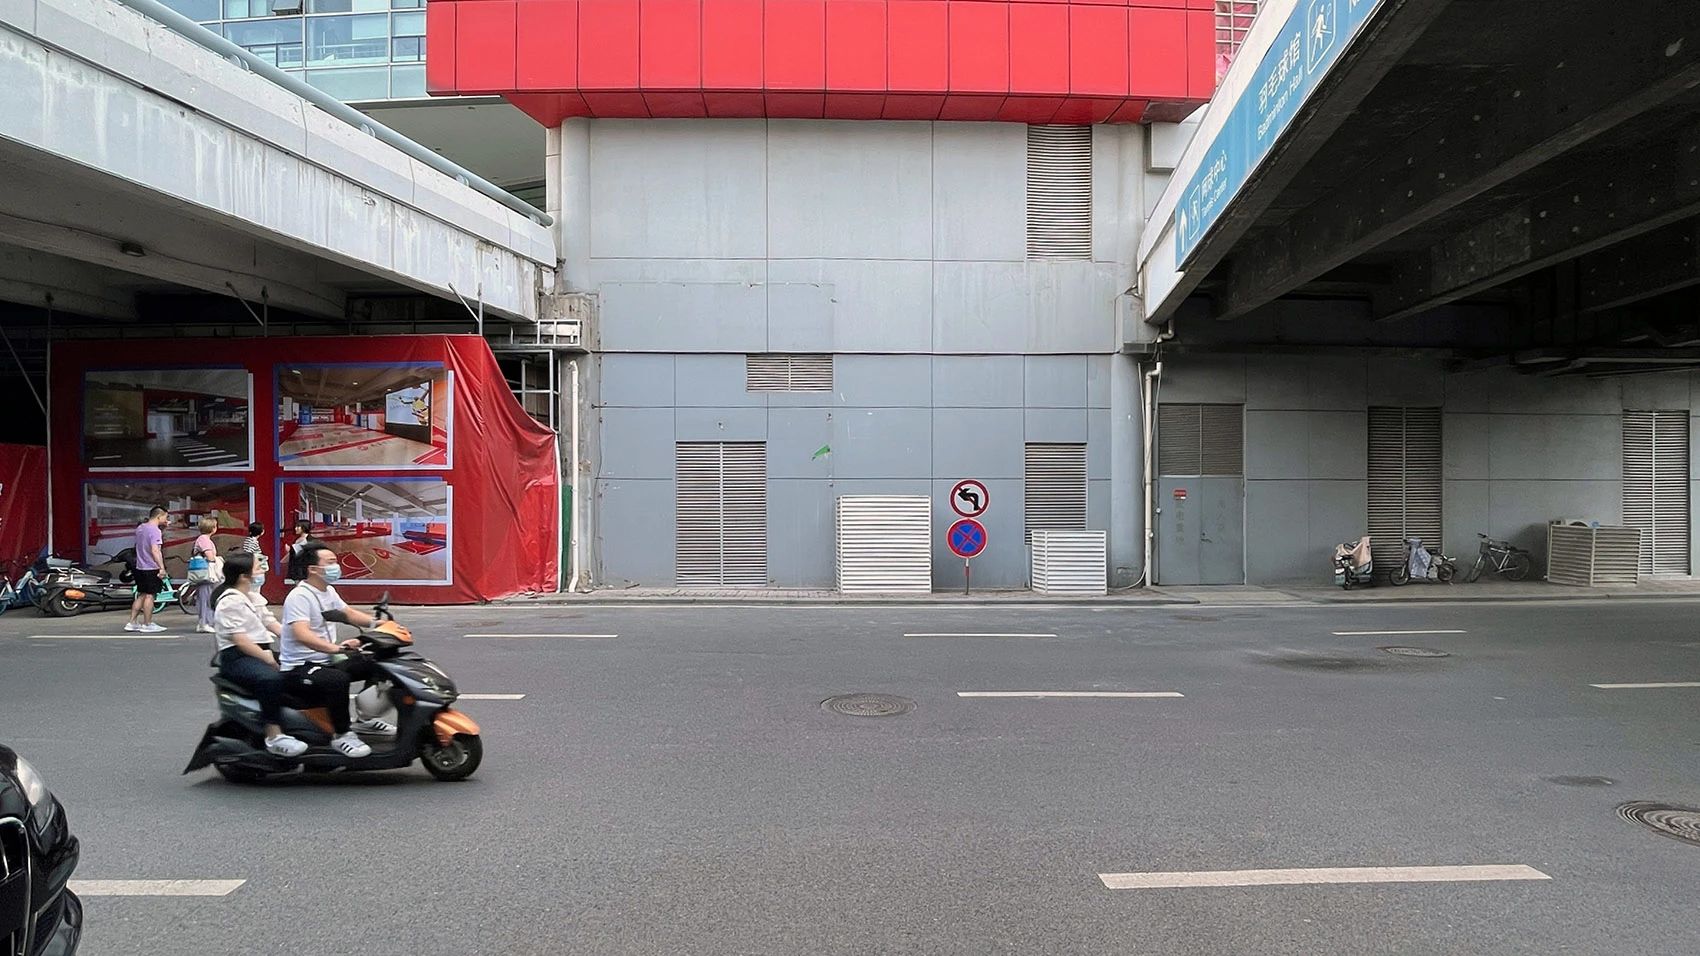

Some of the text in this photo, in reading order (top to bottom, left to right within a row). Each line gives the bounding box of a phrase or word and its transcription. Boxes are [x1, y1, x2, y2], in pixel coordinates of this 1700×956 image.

[1257, 65, 1303, 141] Badminton Hall
[1258, 31, 1301, 114] 羽毛球馆
[1201, 149, 1227, 202] 网球中心
